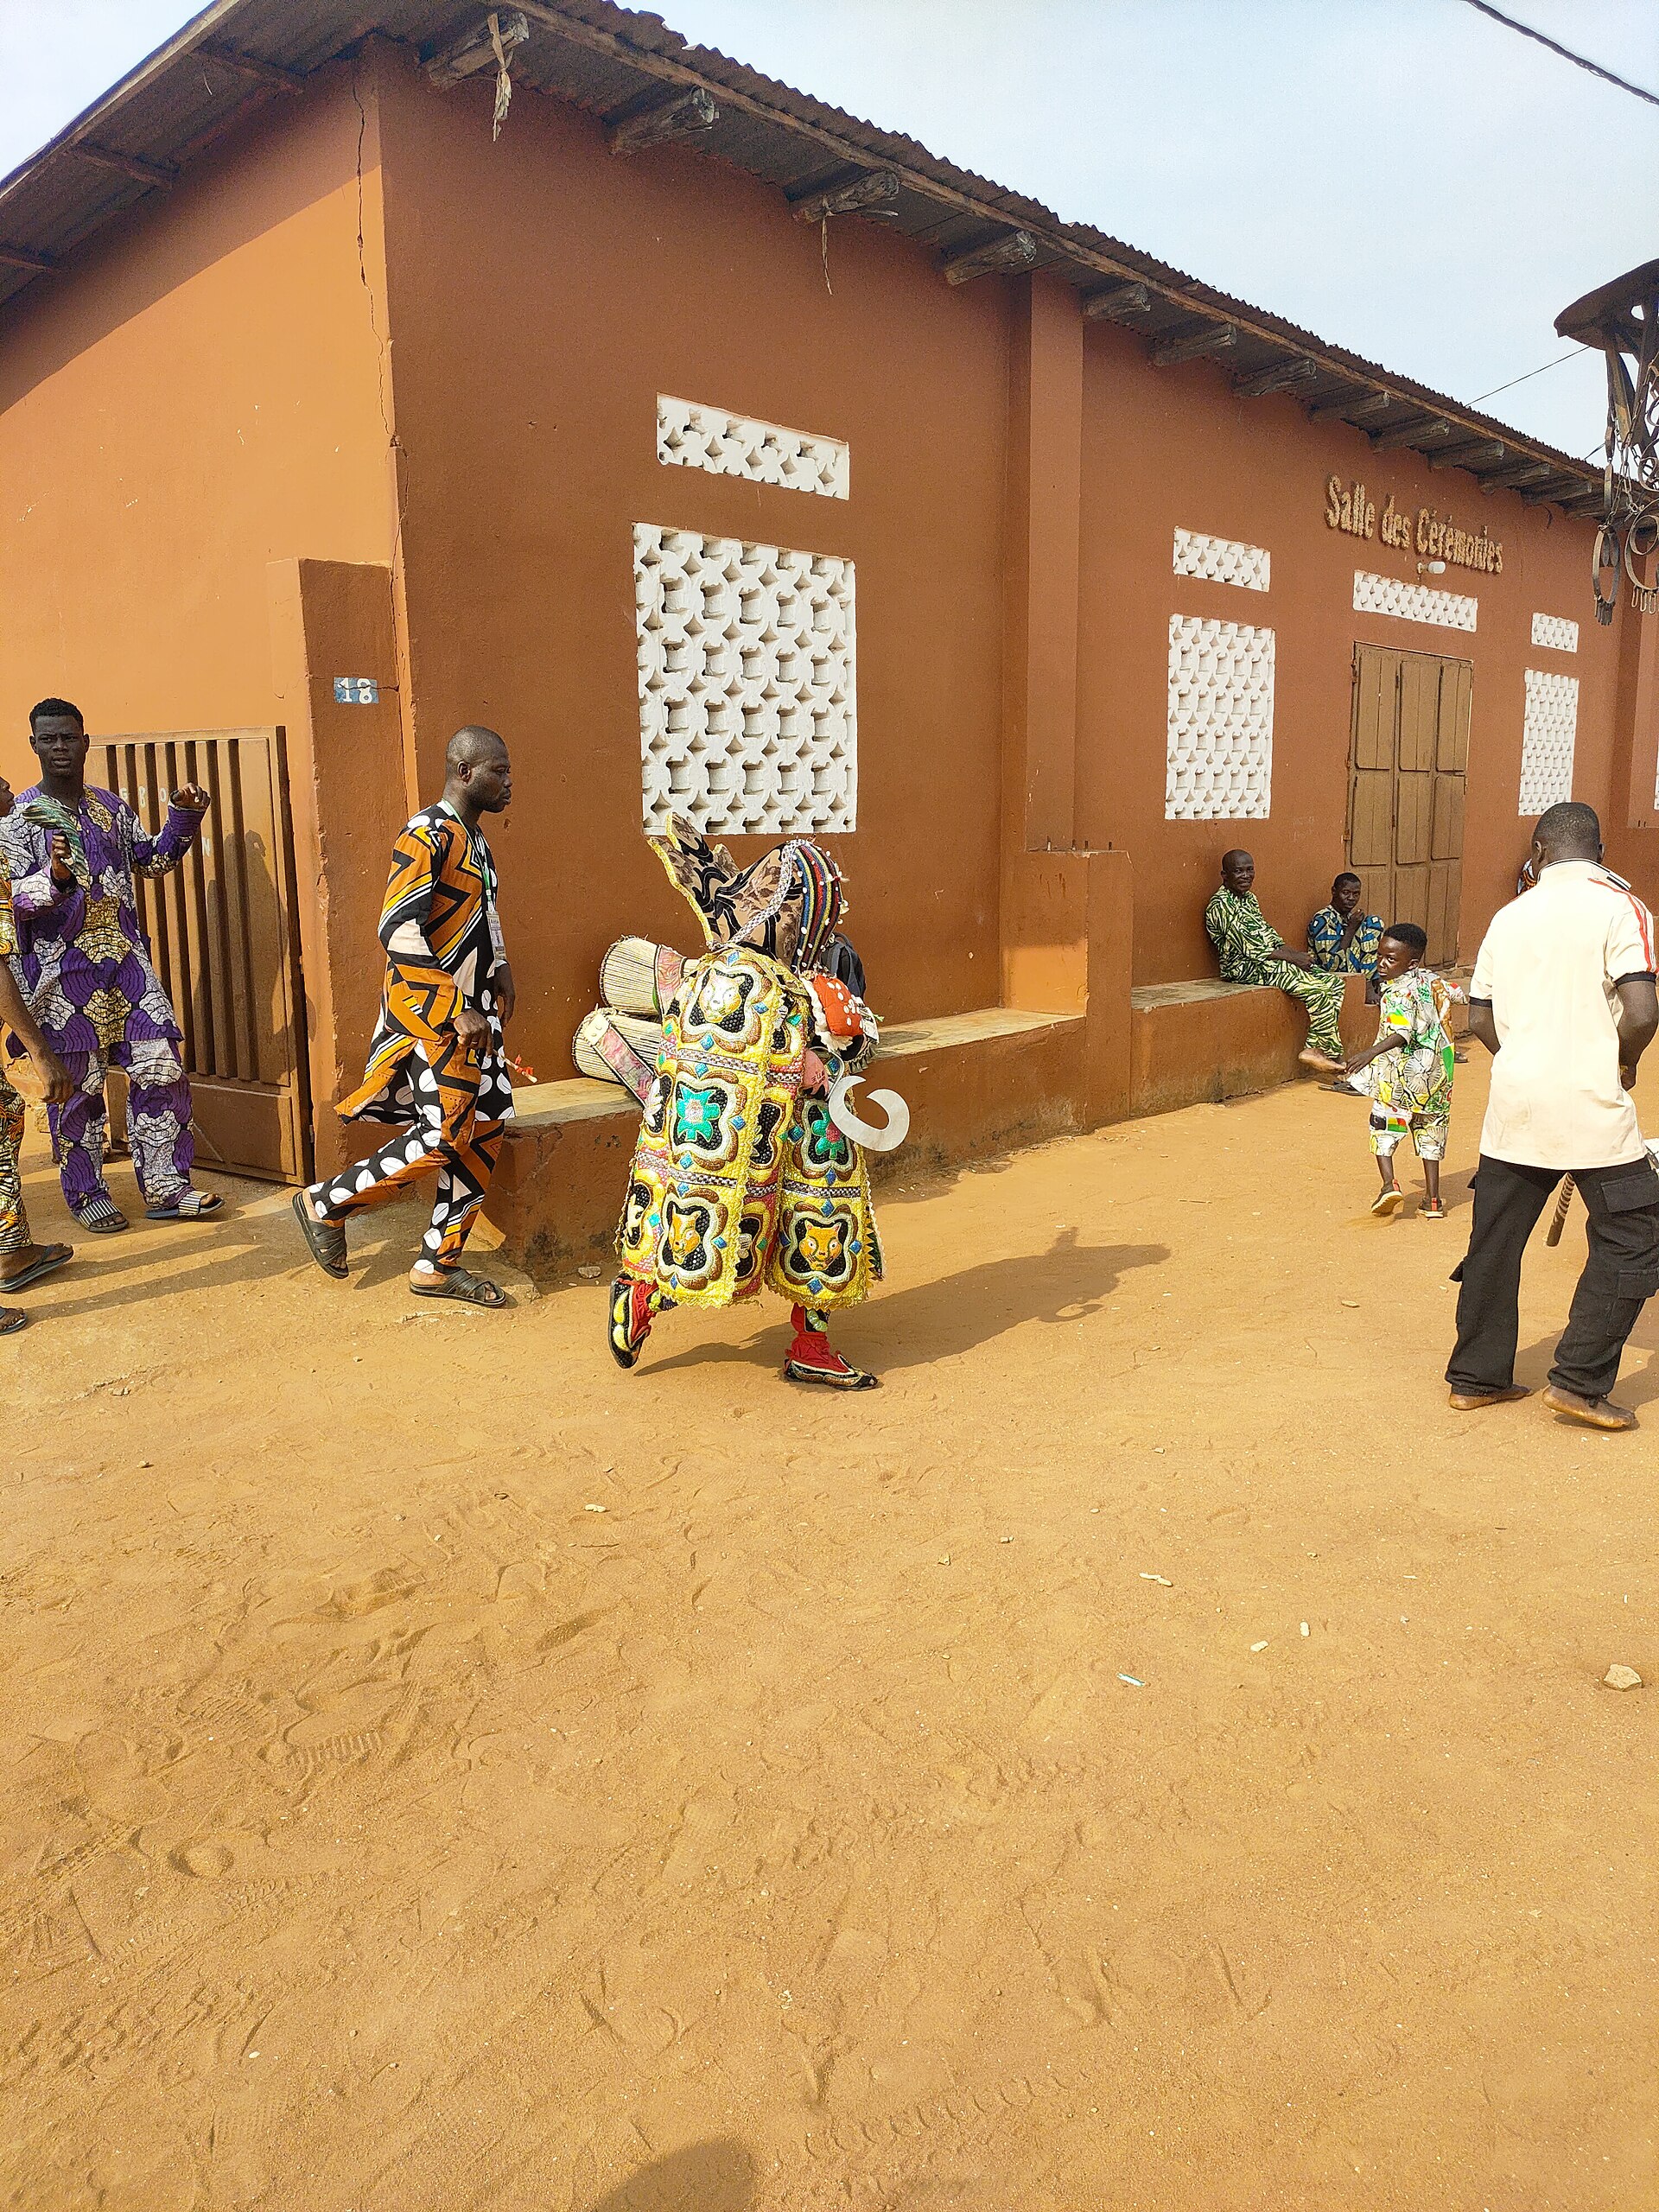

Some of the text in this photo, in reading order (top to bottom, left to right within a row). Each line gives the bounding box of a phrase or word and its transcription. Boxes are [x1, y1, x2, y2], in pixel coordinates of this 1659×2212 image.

[1325, 474, 1503, 574] Salle des Cérémonies
[337, 677, 373, 704] 18
